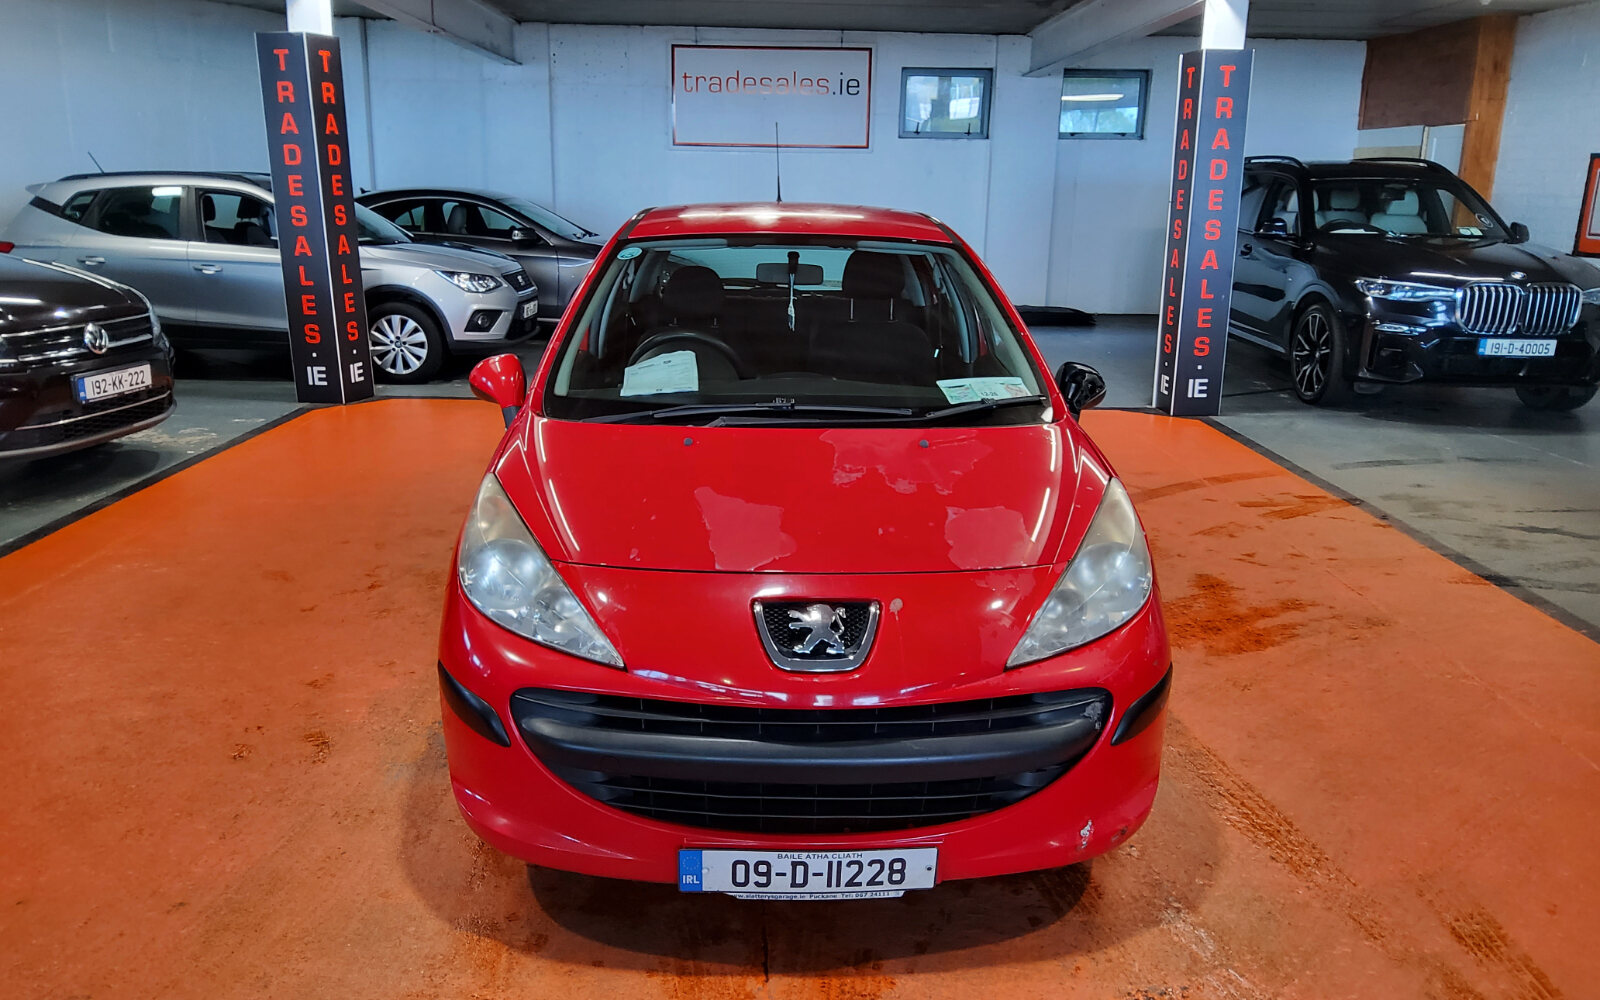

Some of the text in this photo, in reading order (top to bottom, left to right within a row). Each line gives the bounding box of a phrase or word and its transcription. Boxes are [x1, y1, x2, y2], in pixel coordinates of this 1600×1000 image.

[682, 70, 860, 96] tradesales.ie
[1490, 342, 1551, 354] 191-D-40005
[91, 370, 146, 397] 192-KK-222
[831, 852, 863, 860] CLIATH
[682, 874, 700, 884] IRL
[731, 857, 907, 889] 09-D-11228
